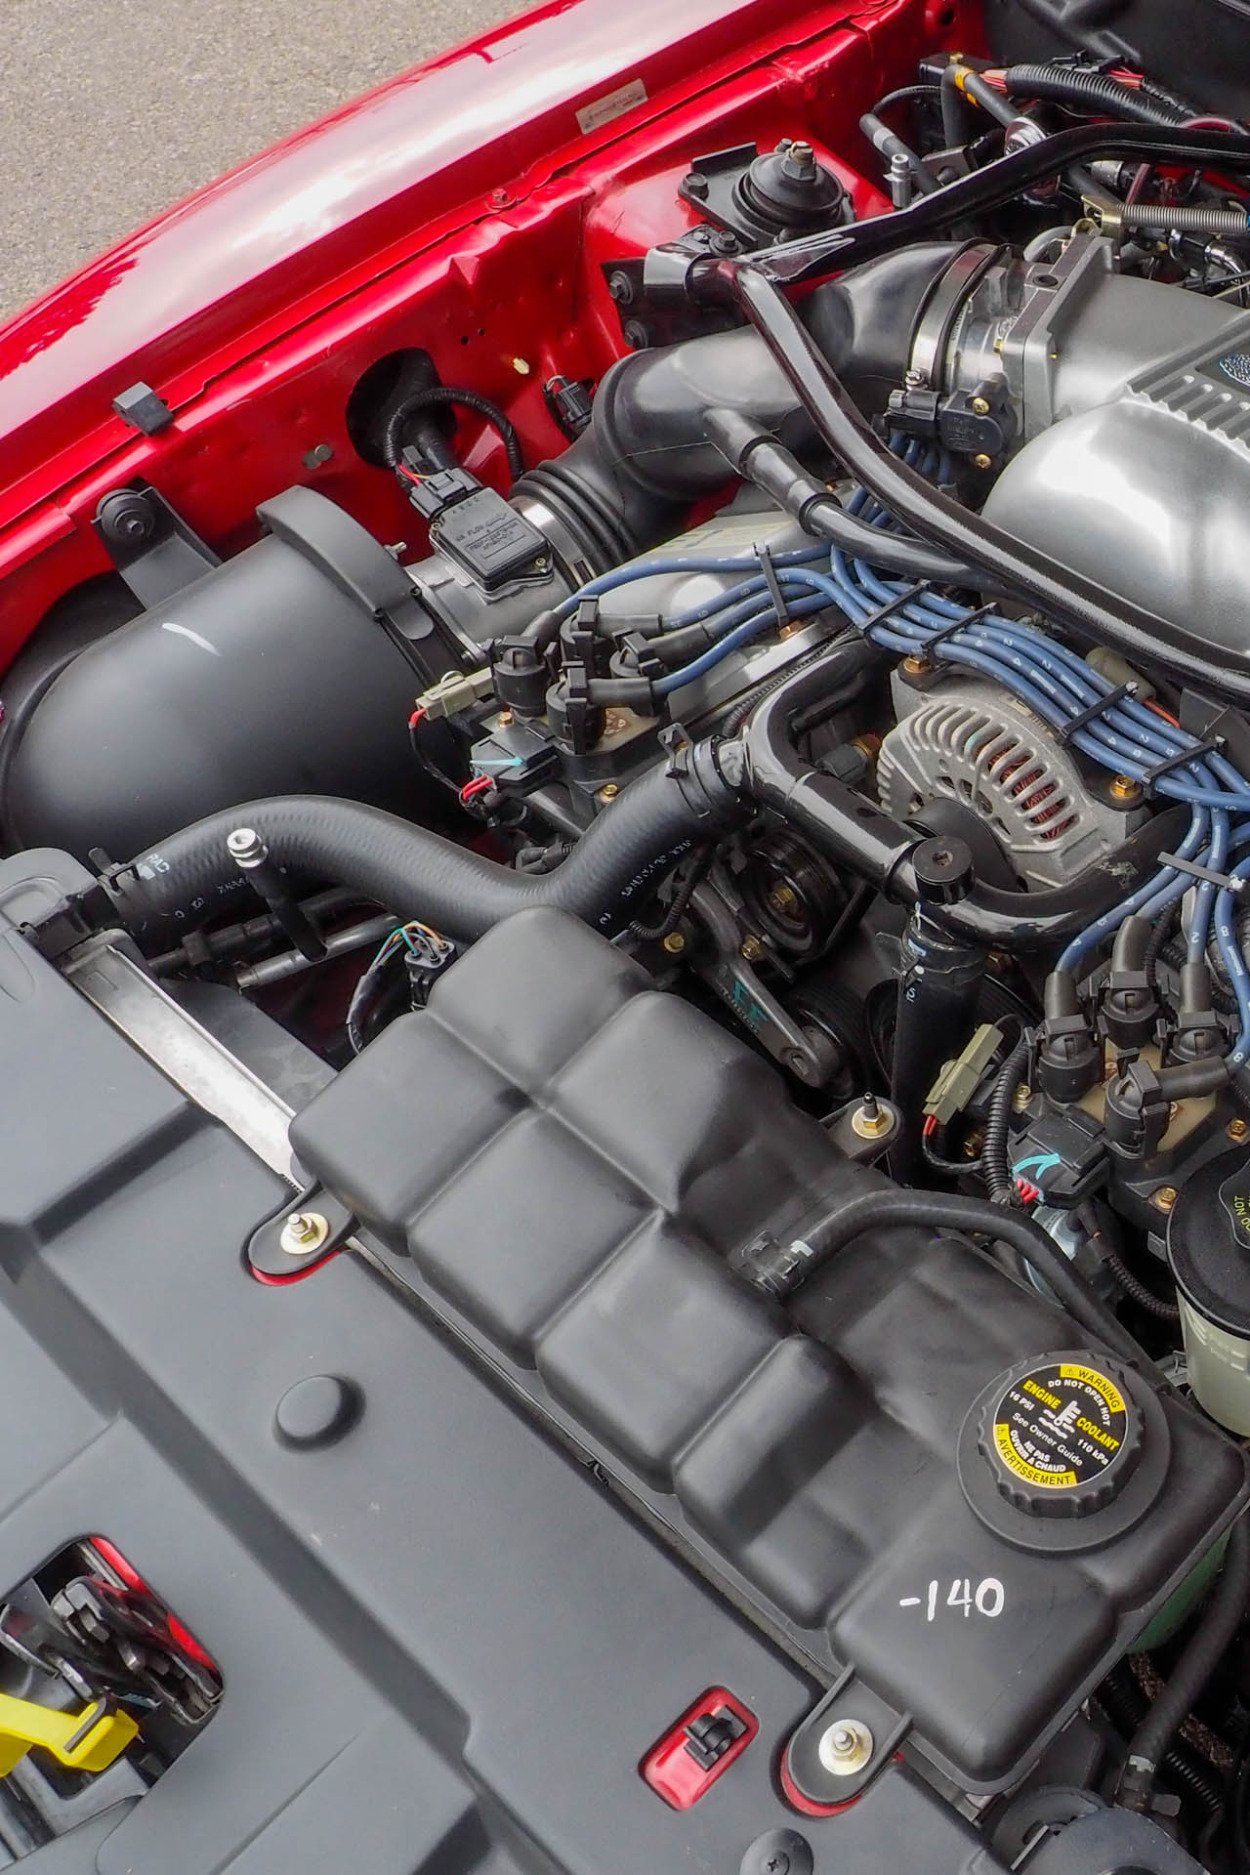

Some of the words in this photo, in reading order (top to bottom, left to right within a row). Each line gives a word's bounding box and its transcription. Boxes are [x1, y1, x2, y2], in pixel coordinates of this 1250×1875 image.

[1233, 1195, 1247, 1217] NOT
[1008, 1391, 1021, 1403] 16
[1019, 1395, 1035, 1412] PSI
[1047, 1379, 1062, 1389] DO
[1064, 1379, 1085, 1389] NOT
[1084, 1384, 1105, 1408] OPEN
[1099, 1405, 1111, 1427] HOT
[1078, 1368, 1121, 1409] WARNING
[1022, 1379, 1061, 1410] ENGINE
[1076, 1416, 1121, 1452] COOLANT
[1010, 1429, 1030, 1462] OUVRIR
[1034, 1459, 1067, 1473] CHAUD
[1011, 1411, 1030, 1428] See
[1029, 1423, 1057, 1448] Owner
[1056, 1443, 1084, 1468] Guide
[1023, 1440, 1038, 1455] NE
[1033, 1448, 1051, 1463] PAS
[1077, 1437, 1095, 1454] 110
[1092, 1449, 1109, 1466] kPa
[998, 1438, 1071, 1486] AVERTISSEMENT
[899, 1577, 1005, 1621] -140
